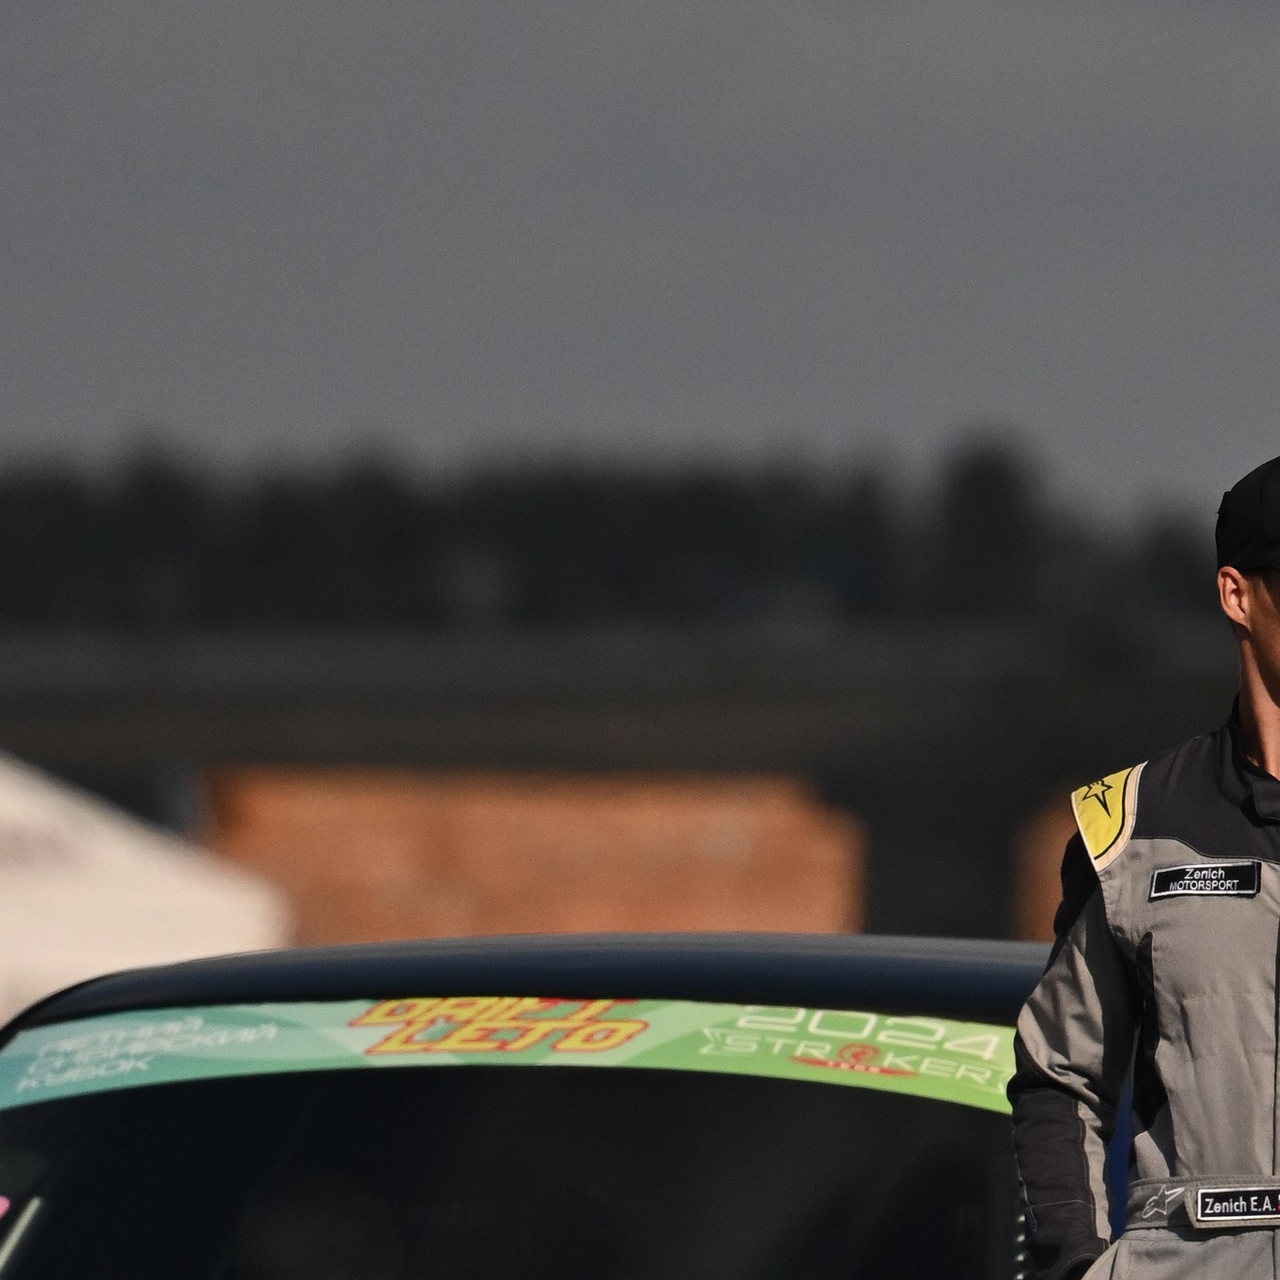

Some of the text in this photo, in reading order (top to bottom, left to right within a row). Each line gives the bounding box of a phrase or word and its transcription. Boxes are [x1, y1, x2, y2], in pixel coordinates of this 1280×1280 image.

[1184, 867, 1225, 880] Zenich
[1169, 880, 1239, 891] MOTORSPORT
[365, 1020, 650, 1055] LETO
[736, 1005, 1000, 1060] 2024
[1204, 1196, 1276, 1214] Zenich E.A.
